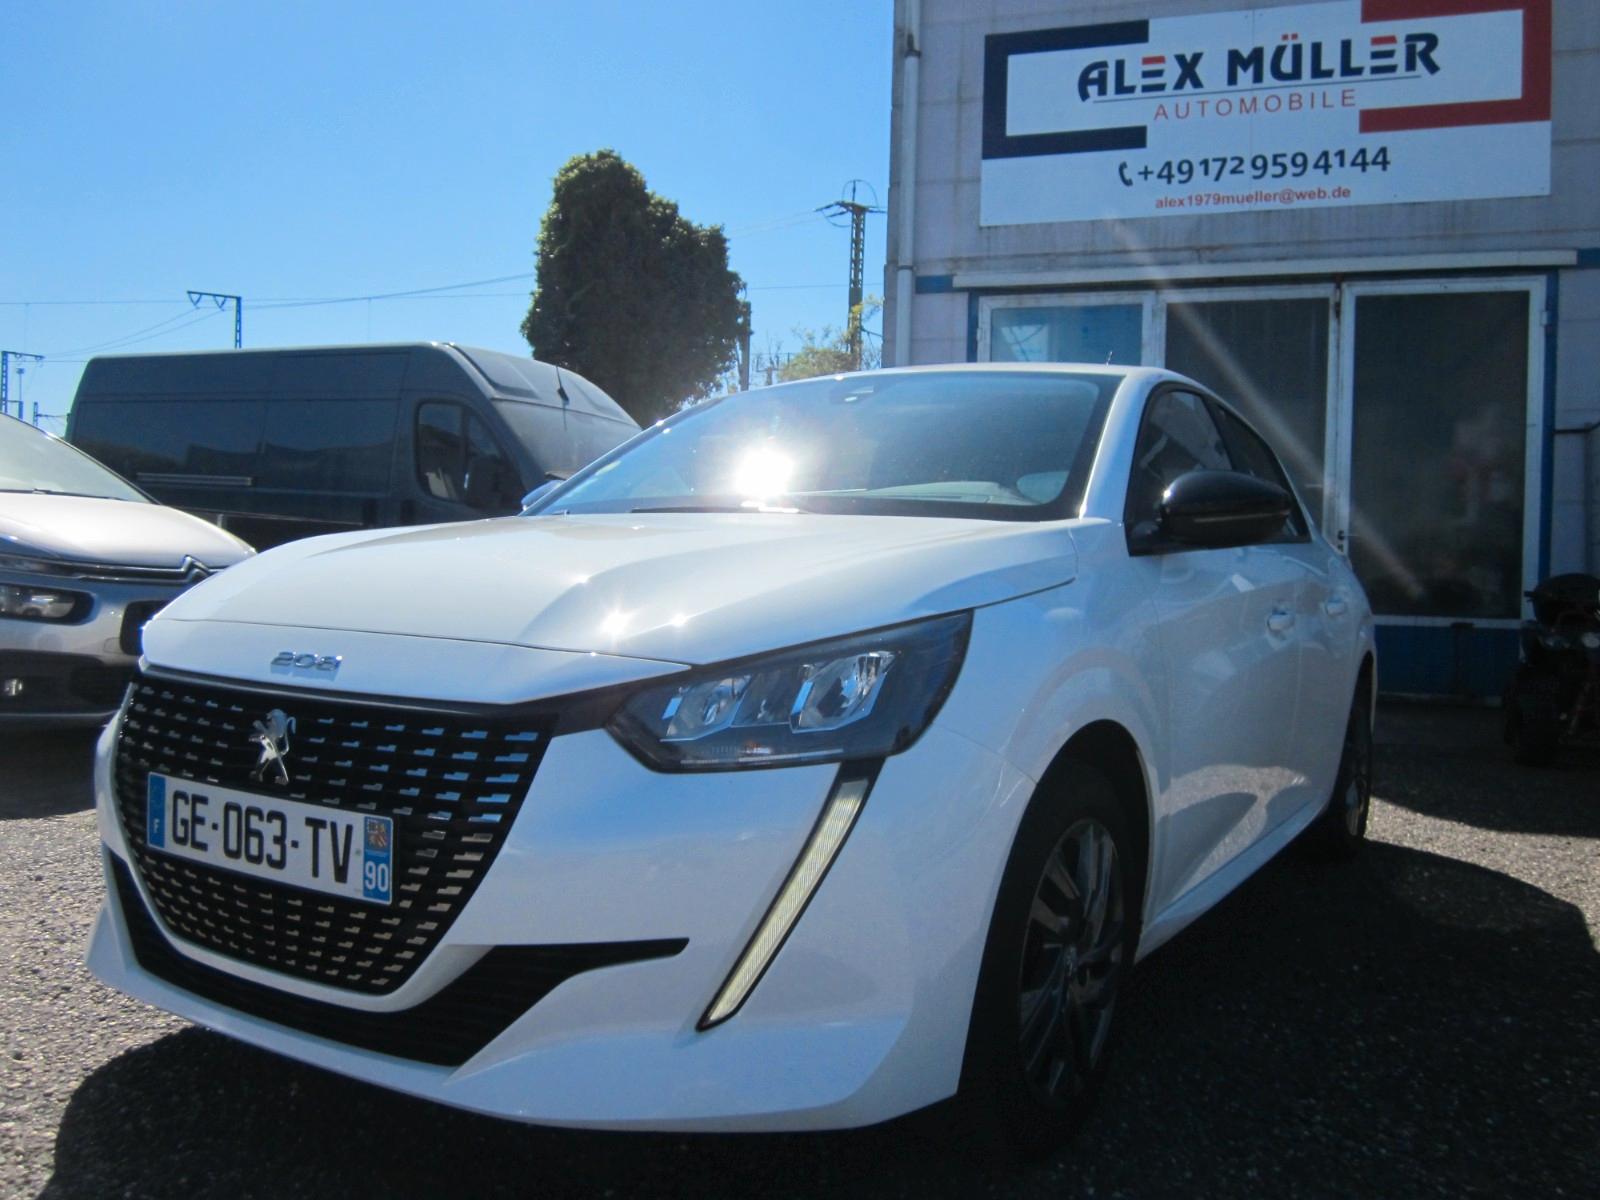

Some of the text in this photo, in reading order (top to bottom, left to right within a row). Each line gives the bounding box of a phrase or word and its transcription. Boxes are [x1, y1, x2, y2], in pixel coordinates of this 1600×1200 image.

[1078, 32, 1441, 102] ALEX MÜLLER
[1153, 89, 1357, 120] AUTOMOBILE
[1155, 186, 1351, 209] alex1979mueller@web.de
[270, 651, 342, 672] 208
[172, 790, 353, 884] GE-063-TV
[365, 860, 389, 892] 90
